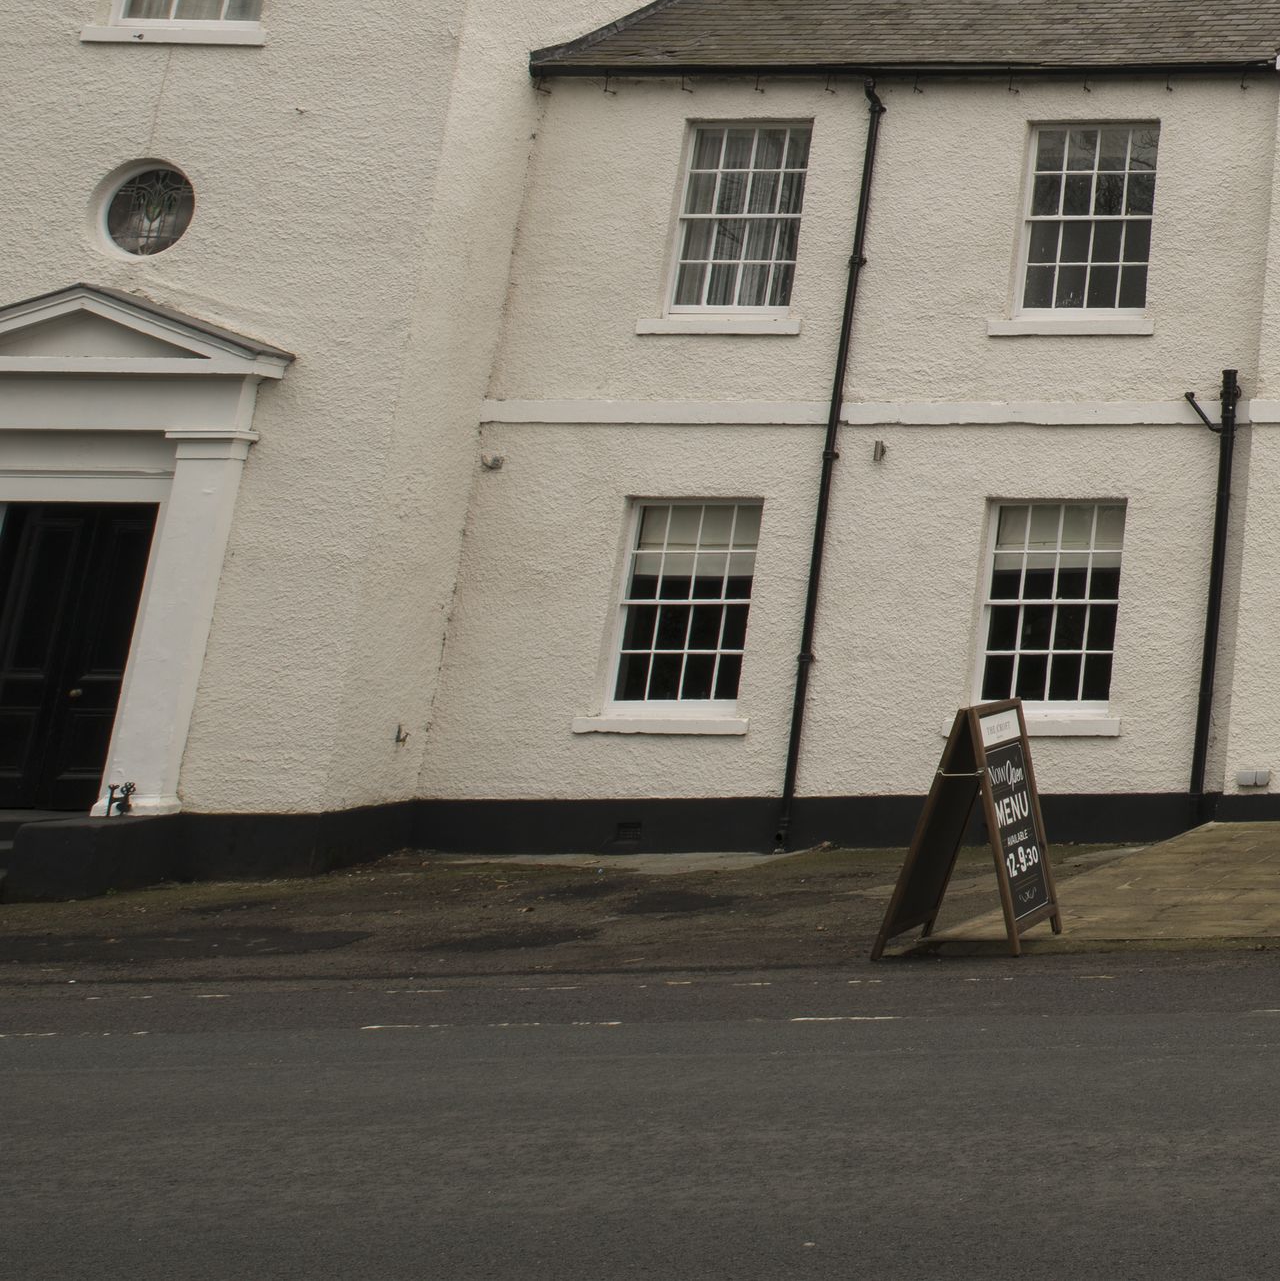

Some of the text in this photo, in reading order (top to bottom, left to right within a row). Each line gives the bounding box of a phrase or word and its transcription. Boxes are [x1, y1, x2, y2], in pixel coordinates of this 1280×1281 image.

[1006, 759, 1024, 791] Open
[994, 791, 1029, 829] MENU
[1007, 829, 1028, 847] AVAILABLE
[1006, 846, 1039, 878] 12-9:30
